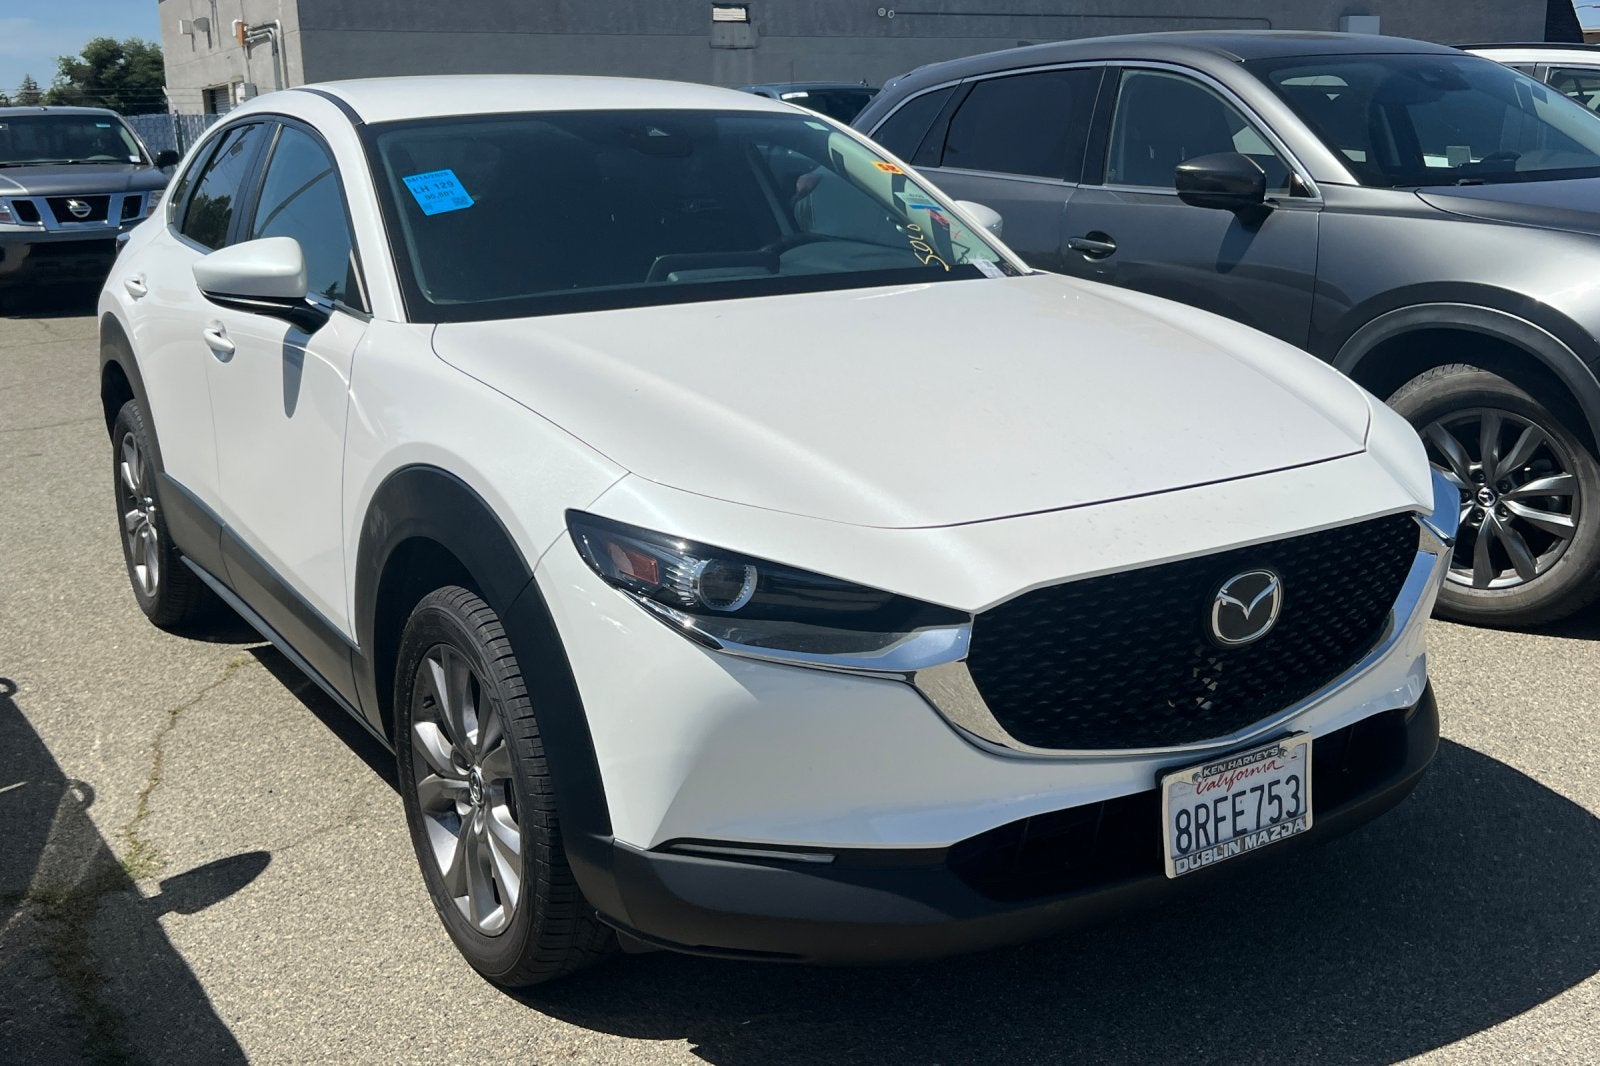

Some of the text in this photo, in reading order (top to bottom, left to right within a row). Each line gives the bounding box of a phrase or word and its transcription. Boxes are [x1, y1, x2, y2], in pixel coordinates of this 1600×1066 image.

[413, 181, 454, 194] LH 129
[1196, 759, 1284, 795] California
[1202, 747, 1279, 777] KEN HARVEY'S
[1175, 774, 1300, 854] 8RFE753
[1175, 818, 1306, 875] DUBLIN MAZDA
